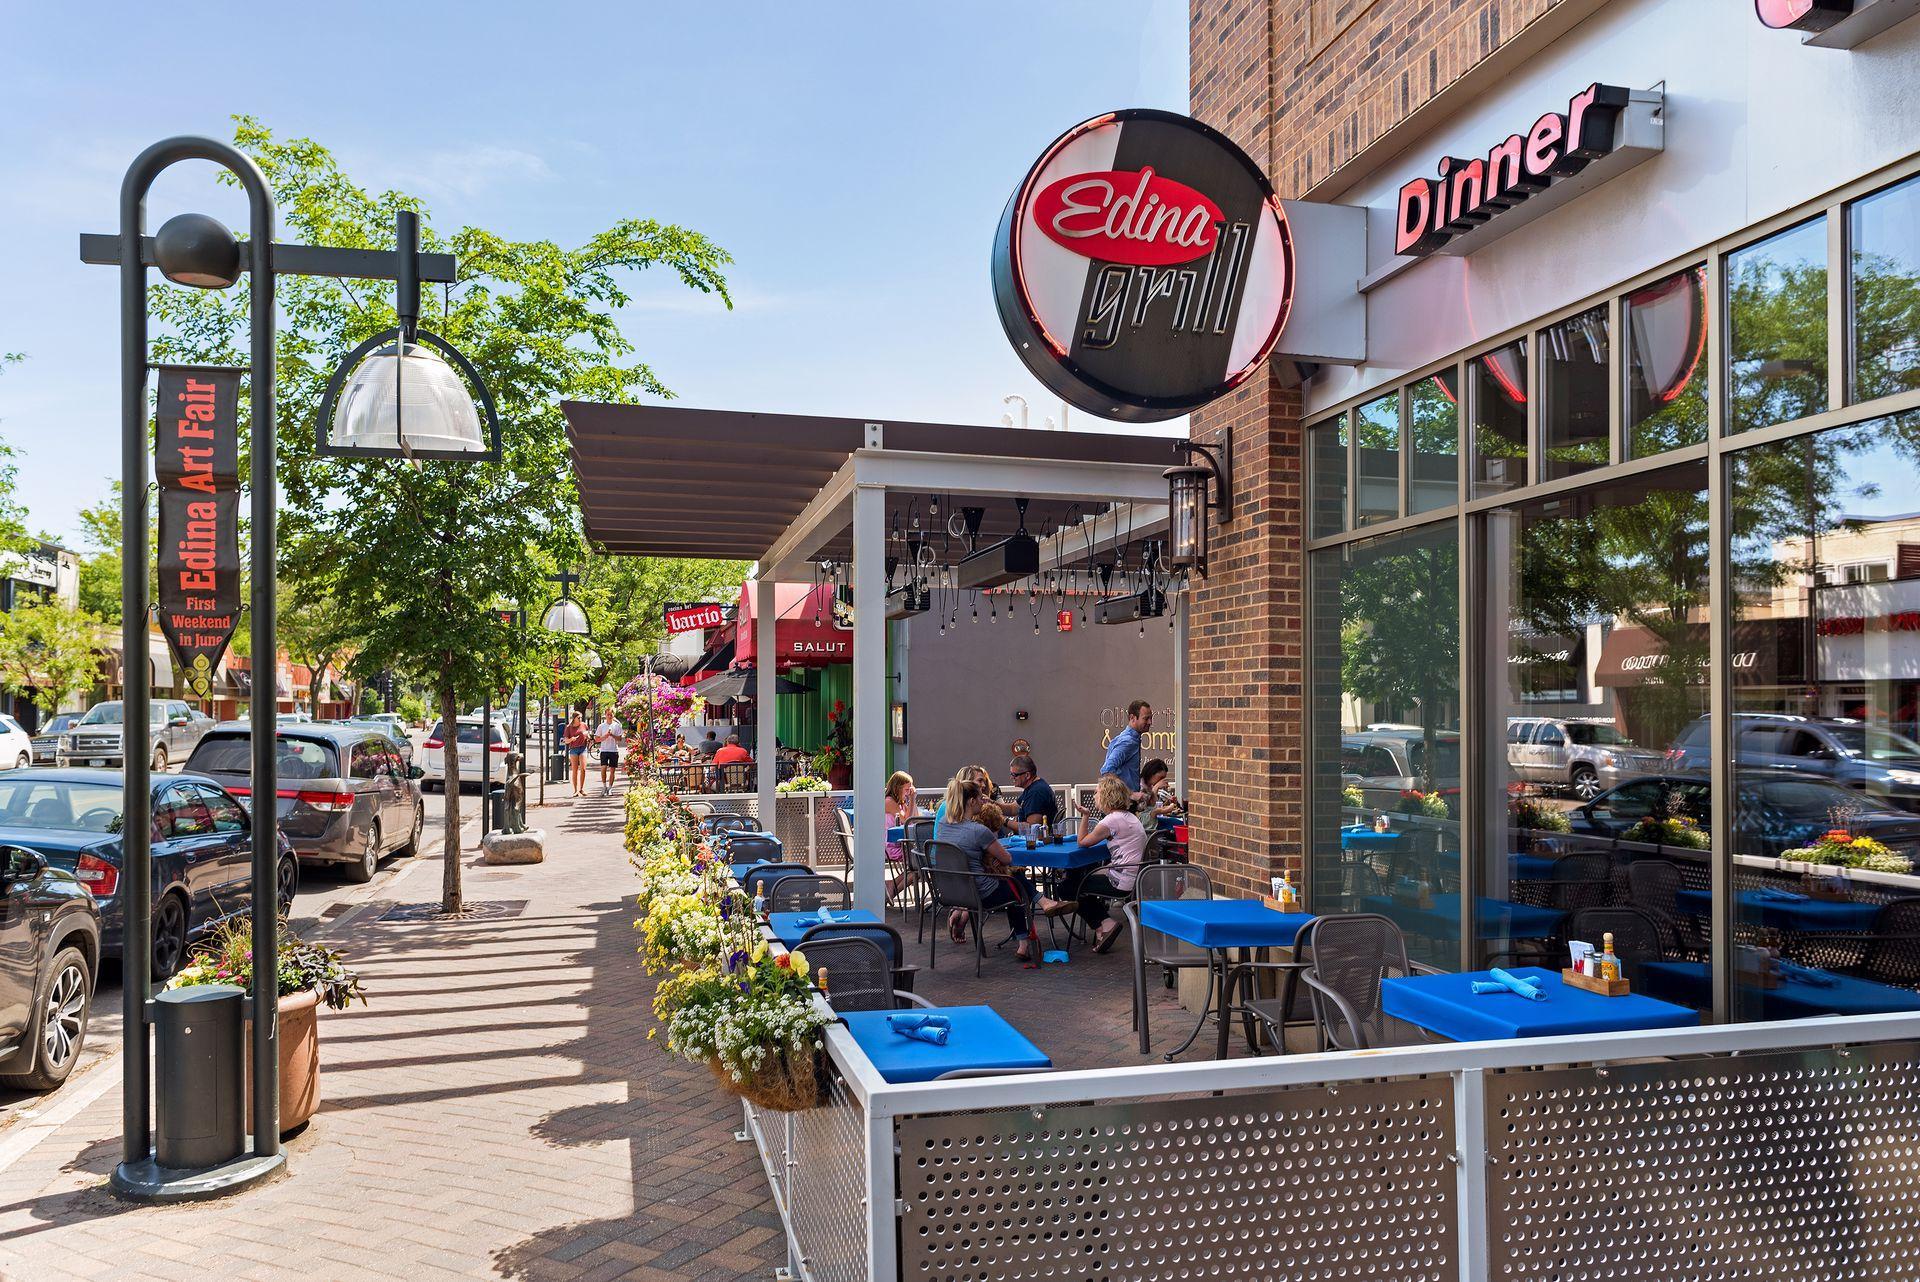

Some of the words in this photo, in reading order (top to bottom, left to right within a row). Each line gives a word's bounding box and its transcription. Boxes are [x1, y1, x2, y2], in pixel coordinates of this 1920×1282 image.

[1395, 82, 1598, 256] Dinner
[1052, 170, 1211, 248] Edina
[1082, 221, 1250, 349] grill
[177, 378, 217, 440] Fair
[177, 446, 217, 495] Art
[179, 501, 217, 591] Edina
[171, 614, 231, 629] Weekend
[186, 596, 217, 611] First
[669, 607, 720, 631] barrio
[179, 632, 192, 647] in
[194, 633, 223, 649] June
[793, 642, 846, 652] SALUT
